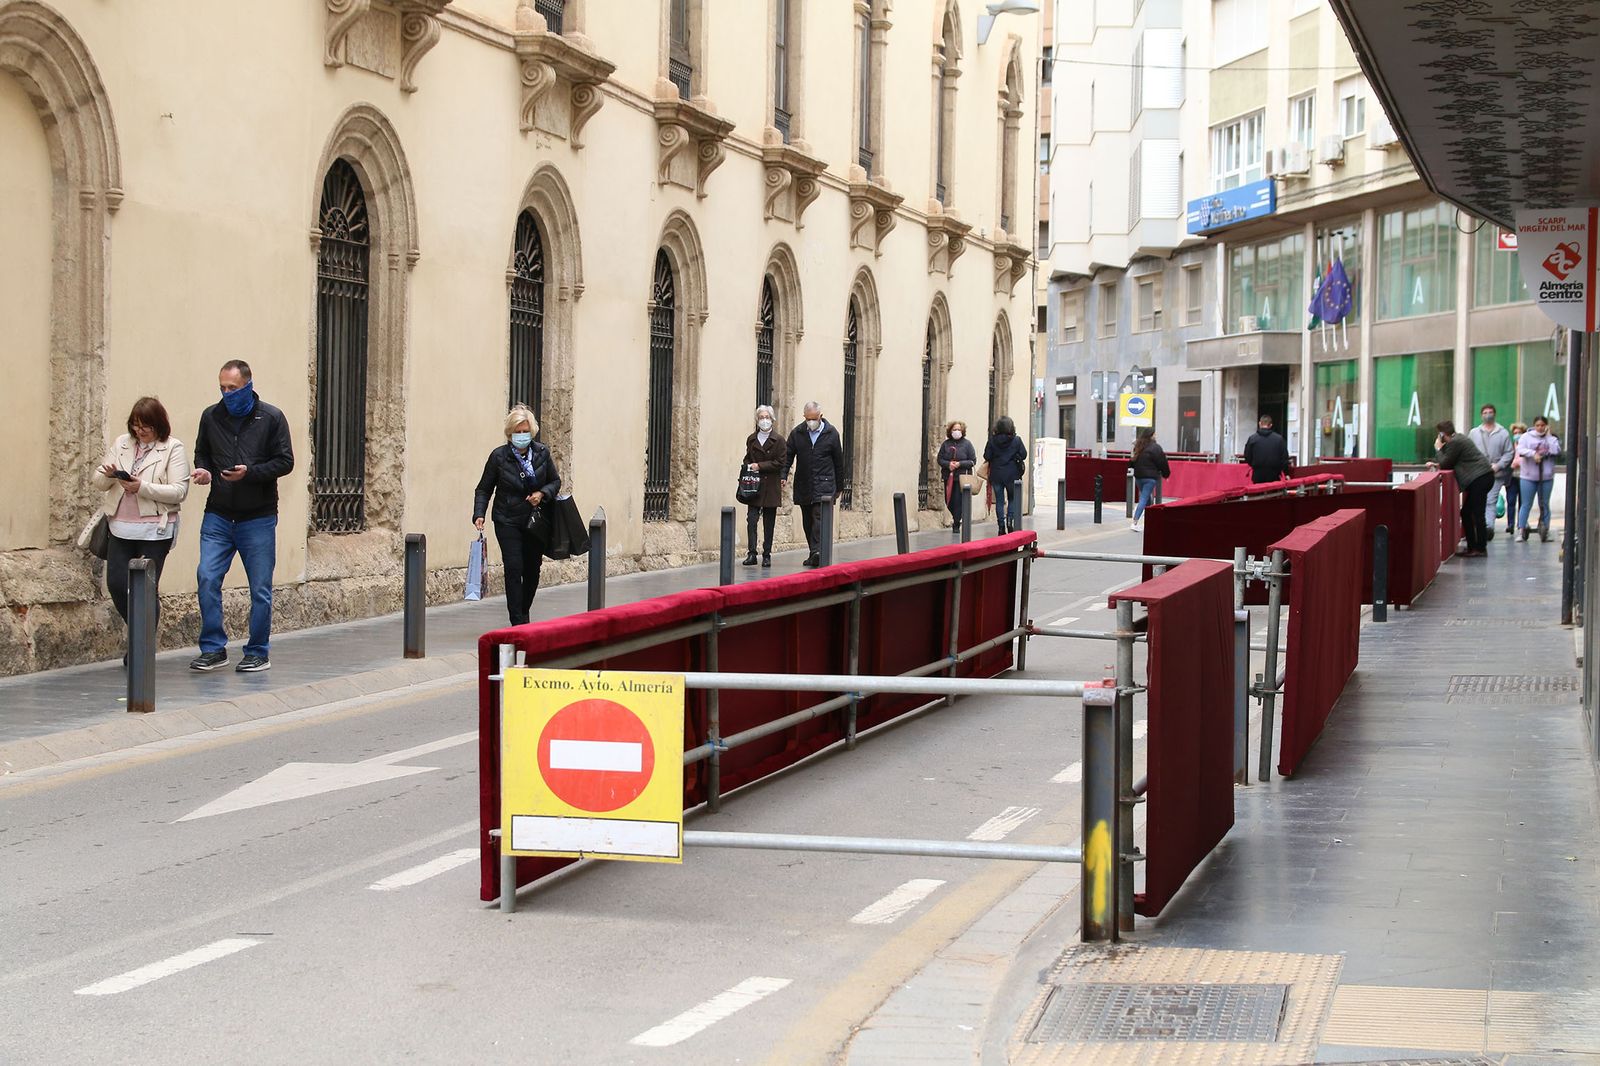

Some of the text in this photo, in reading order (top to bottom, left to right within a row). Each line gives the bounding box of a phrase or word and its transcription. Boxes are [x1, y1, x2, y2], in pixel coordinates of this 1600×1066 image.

[1538, 217, 1566, 225] SCARPI
[1518, 223, 1586, 233] VIRGEN DEL MAR
[1539, 280, 1584, 291] Almería
[1539, 289, 1583, 300] centro
[522, 676, 674, 694] Excmo. Ayto. Almería
